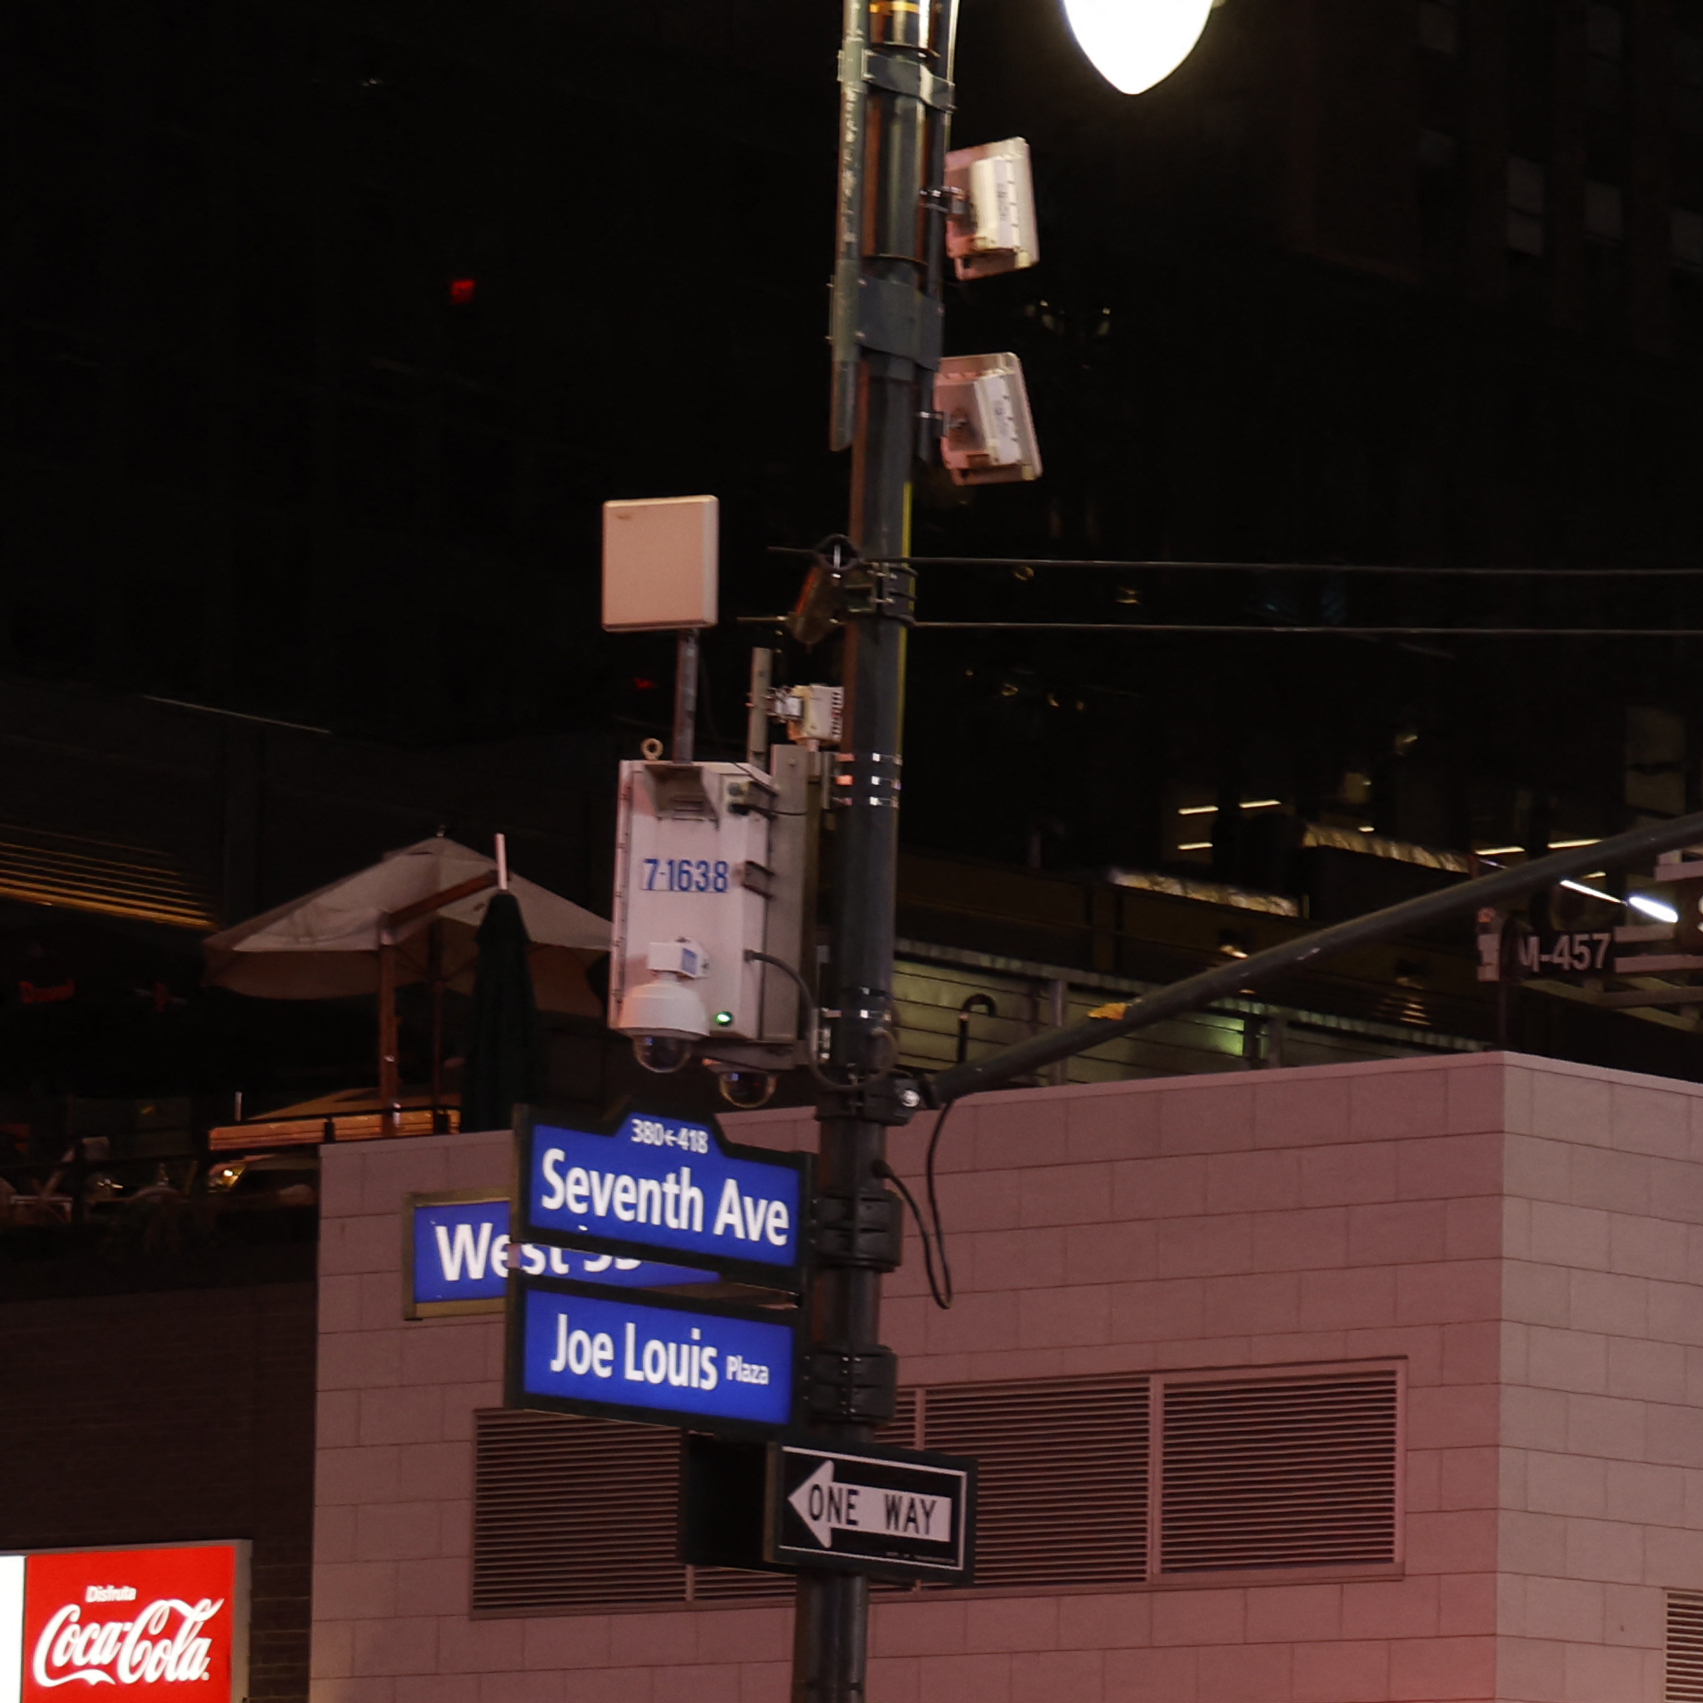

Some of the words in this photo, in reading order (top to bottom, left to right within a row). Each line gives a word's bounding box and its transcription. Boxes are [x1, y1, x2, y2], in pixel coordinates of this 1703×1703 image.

[643, 859, 730, 892] 7-1638
[541, 1147, 703, 1232] Seventh
[713, 1178, 790, 1247] Ave
[550, 1313, 614, 1379] Joe
[624, 1321, 719, 1391] Louis
[726, 1353, 770, 1386] Plaza
[809, 1482, 860, 1528] ONE
[884, 1492, 938, 1536] WAY
[85, 1584, 138, 1603] Disfruta
[32, 1598, 226, 1688] Coca-Cola
